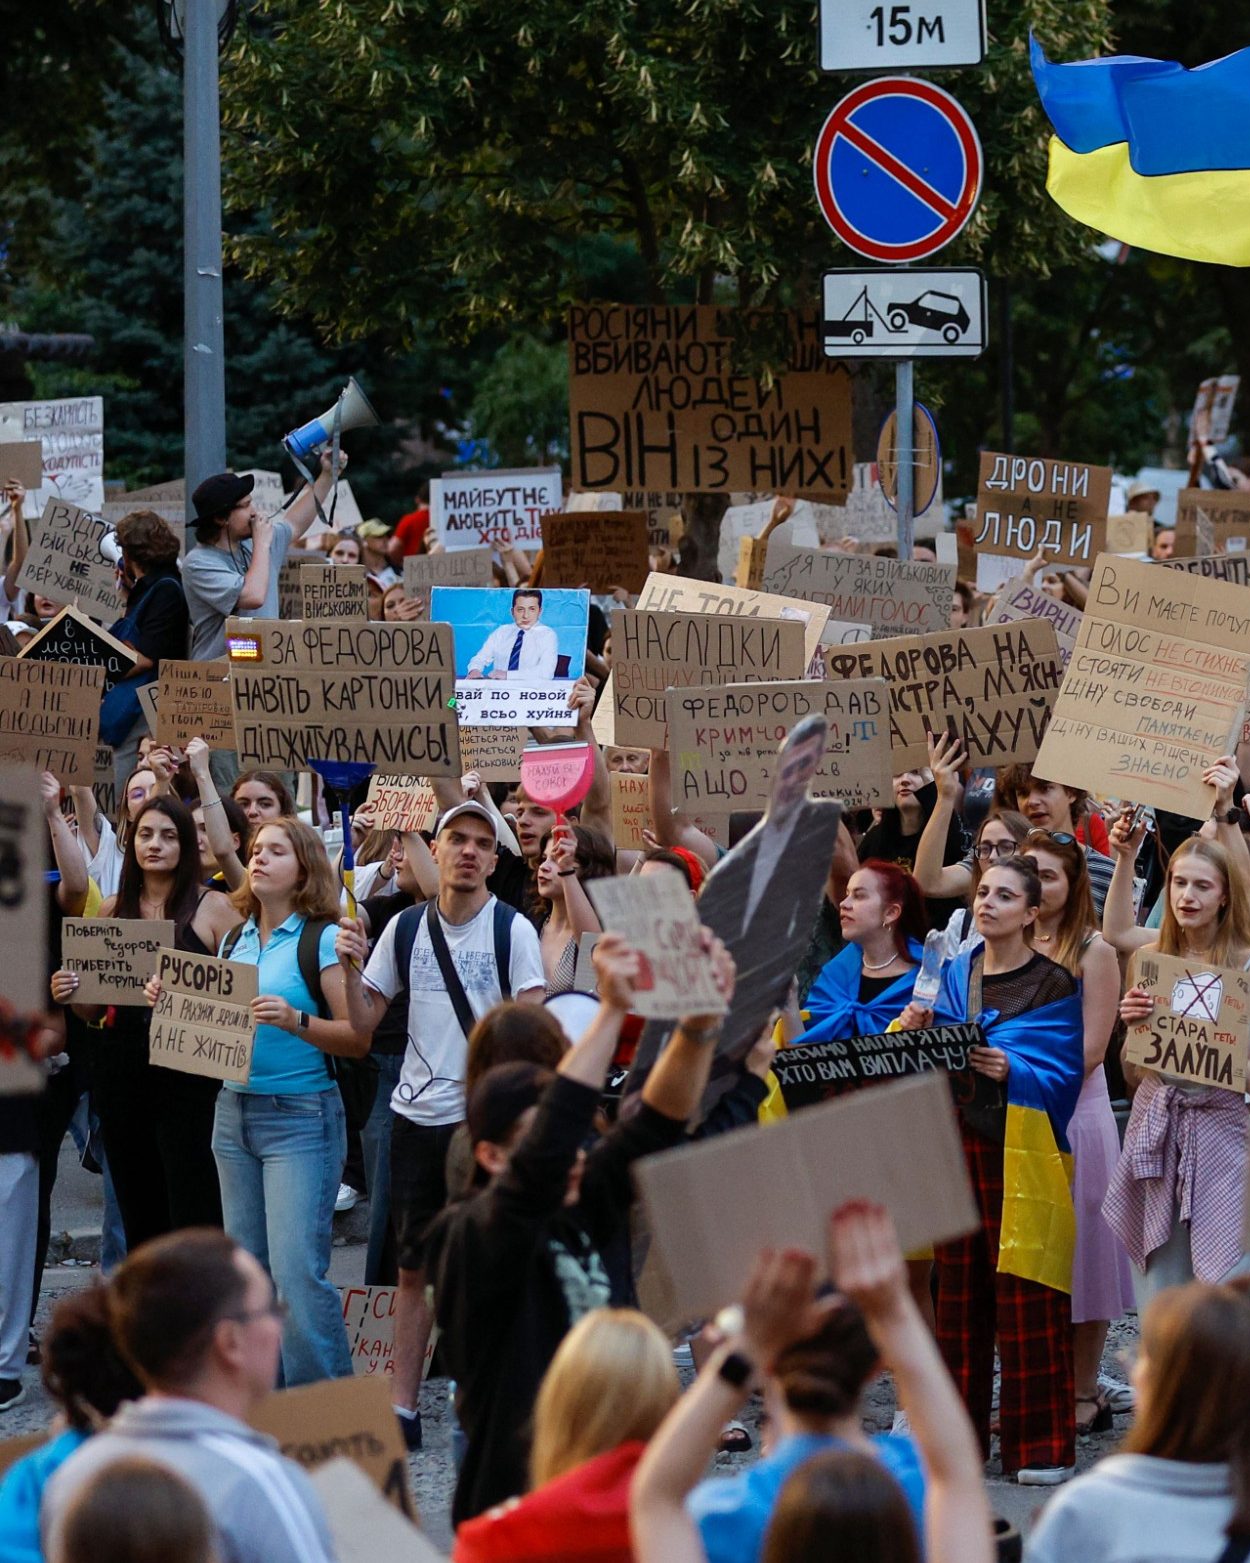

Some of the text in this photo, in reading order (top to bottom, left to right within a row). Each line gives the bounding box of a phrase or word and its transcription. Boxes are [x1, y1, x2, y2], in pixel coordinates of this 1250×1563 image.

[868, 5, 946, 47] 15м
[571, 306, 698, 341] РОСІЯНИ
[632, 375, 783, 412] ЛЮДЕЙ
[578, 407, 821, 488] ВІН ОДИН
[694, 444, 847, 489] ІЗ НИХ!
[985, 455, 1090, 498] ДРОНИ
[444, 486, 550, 510] МАЙБУТНЄ
[1022, 498, 1079, 520] А НЕ
[446, 509, 524, 531] ЛЮБИТЬ
[975, 511, 1092, 560] ЛЮДИ
[69, 559, 90, 576] НЕ
[323, 567, 338, 583] НІ
[801, 555, 951, 585] Я ТУТ ЗА ВІЙСЬКОВИХ
[834, 575, 895, 597] У ЯКИХ
[305, 600, 366, 618] ВІЙСЬКОВИХ
[868, 597, 931, 626] ГОЛОС
[1148, 595, 1201, 622] МАЄТЕ
[271, 627, 445, 668] ЗА ФЕДОРОВА
[624, 614, 782, 670] НАСЛІДКИ
[1085, 621, 1151, 654] ГОЛОС
[830, 637, 978, 683] ФЕДОРОВА
[993, 630, 1036, 665] НА
[1077, 655, 1144, 684] СТОЯТИ
[20, 690, 68, 713] А НЕ
[235, 673, 310, 714] НАВІТЬ
[322, 676, 444, 712] КАРТОНКИ
[455, 688, 567, 700] вай по новой
[682, 691, 810, 719] ФЕДОРОВ
[824, 690, 882, 717] ДАВ
[1064, 678, 1198, 721] ЦІНУ СВОБОДИ
[480, 710, 518, 719] всьо
[526, 708, 573, 721] хуйня
[925, 696, 1054, 756] НАХУЙ
[500, 735, 520, 743] ТАМ
[1052, 718, 1209, 769] ЦІНУ ВАШИХ РІШЕНЬ
[35, 749, 79, 775] ГЕТЬ
[1117, 754, 1190, 780] ЗНАЄМО
[457, 950, 496, 962] LIBERT
[98, 972, 150, 990] КОРУПЦІ
[159, 953, 235, 996] РУСОРІЗ
[155, 990, 174, 1017] ЗА
[850, 1023, 982, 1053] НАПАМ'ЯТАТИ
[1157, 1015, 1208, 1043] СТАРА
[153, 1029, 249, 1069] А НЕ ЖИТТІВ
[1143, 1031, 1234, 1086] ЗАЛУПА
[778, 1063, 816, 1087] ХТО
[816, 1058, 857, 1082] ВАМ
